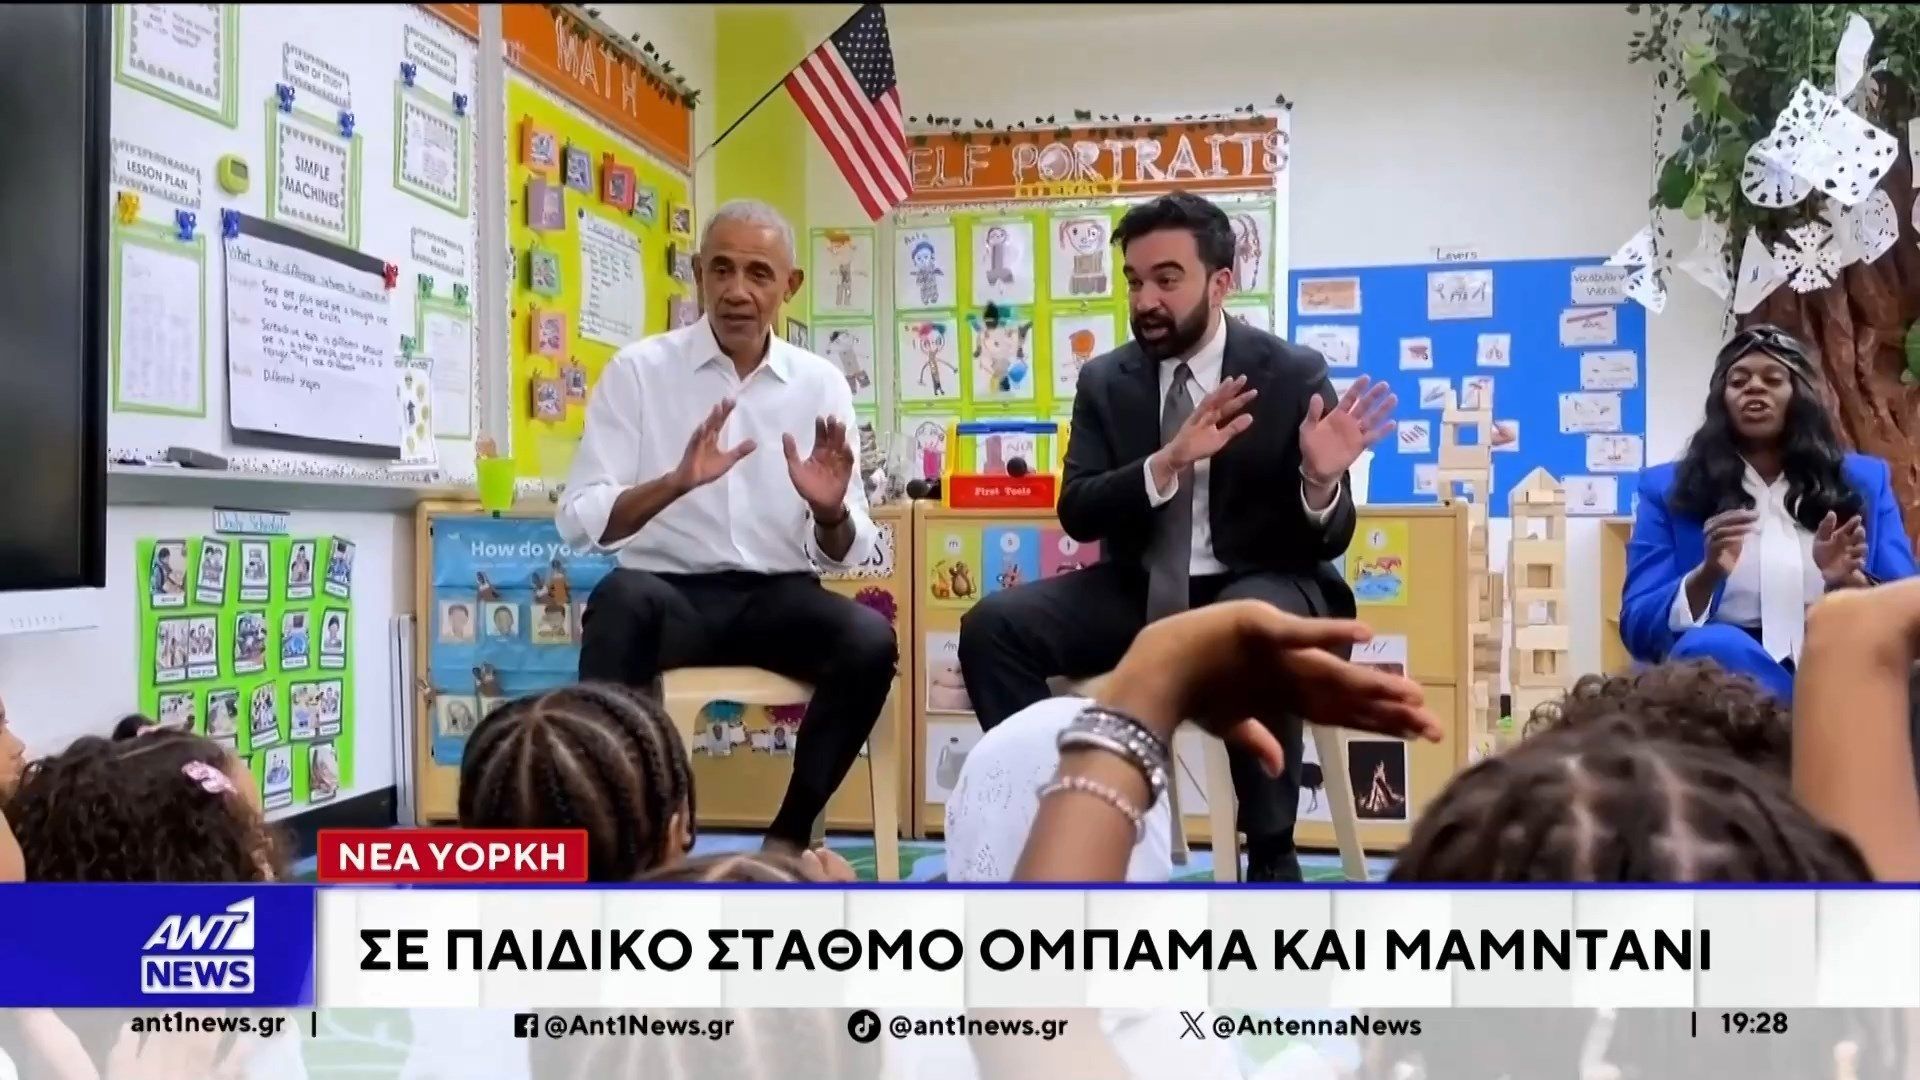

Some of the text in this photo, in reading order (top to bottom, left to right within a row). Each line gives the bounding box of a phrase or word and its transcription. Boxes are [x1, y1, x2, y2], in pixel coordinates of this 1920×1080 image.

[555, 15, 637, 117] MATH
[295, 155, 330, 181] SIMPLE
[908, 129, 1290, 189] ELF PORTRAITS
[127, 160, 188, 190] LESSON PLAN
[285, 175, 339, 208] MACHINES
[975, 486, 1032, 497] First Tools
[471, 541, 515, 557] How
[519, 541, 544, 557] do
